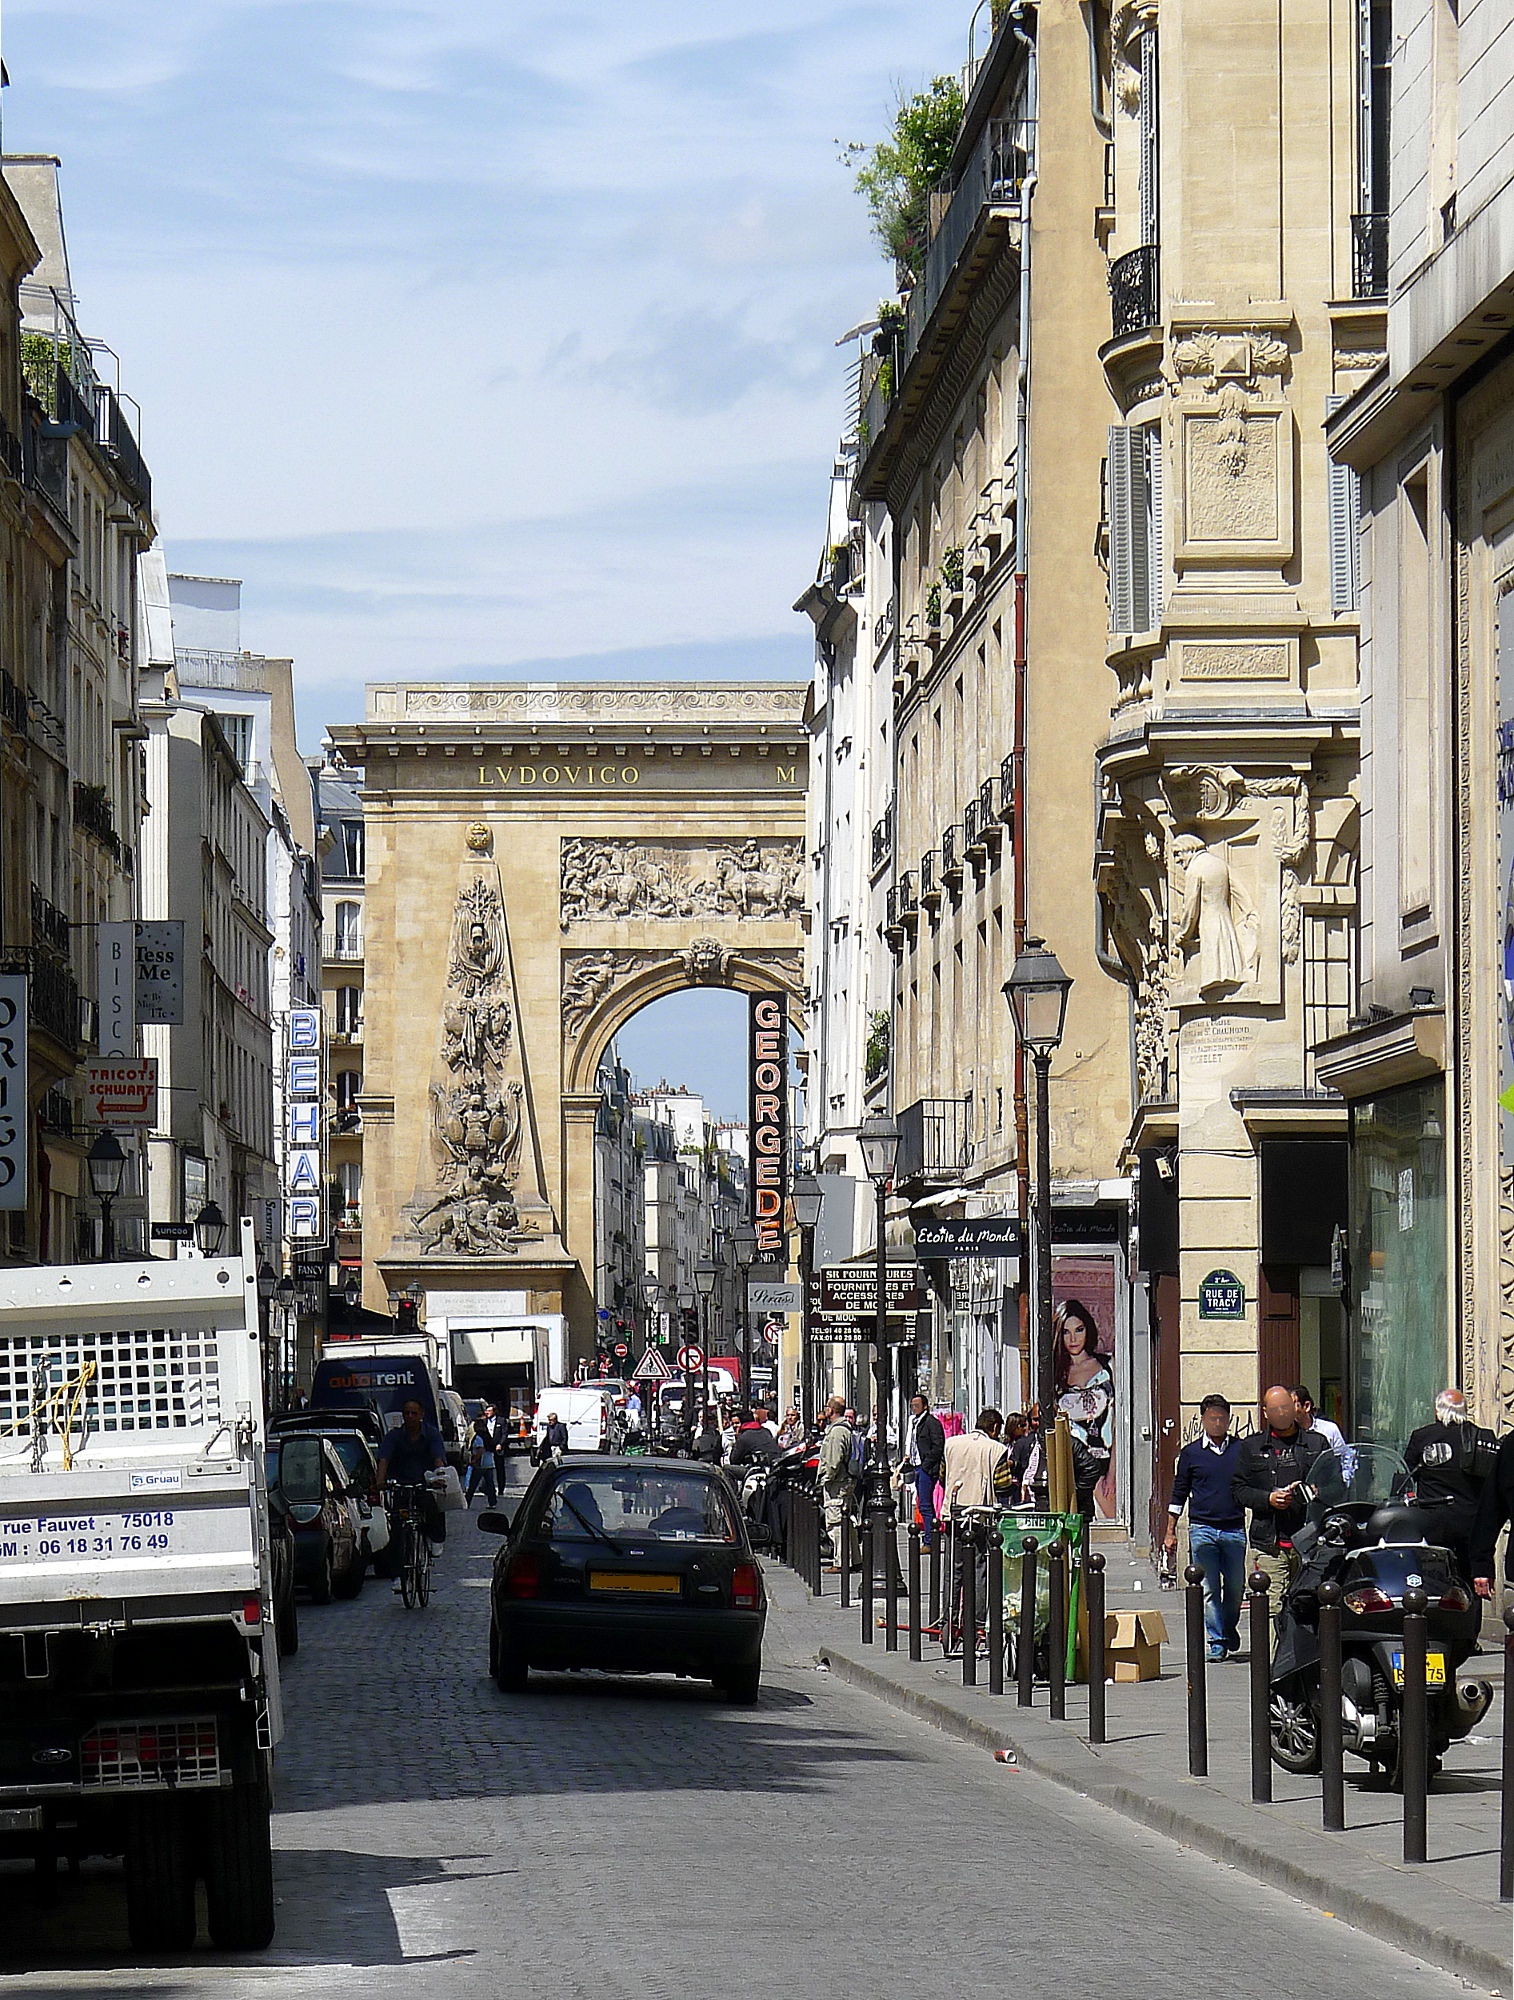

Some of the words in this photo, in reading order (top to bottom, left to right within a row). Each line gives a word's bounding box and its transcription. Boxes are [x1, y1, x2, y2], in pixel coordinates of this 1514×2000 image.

[478, 766, 640, 785] LVDOVICO
[135, 946, 174, 963] Tess
[138, 964, 171, 980] Me
[90, 1069, 155, 1080] TRICOTS
[89, 1084, 155, 1096] SCHWARZ
[291, 1012, 318, 1236] BEHAR
[917, 1226, 955, 1244] Etoile
[957, 1226, 974, 1243] du
[977, 1226, 1017, 1243] Monde
[298, 1265, 324, 1274] FANCY
[843, 1270, 914, 1279] FOURNURES
[827, 1282, 899, 1291] FOURNITUES
[901, 1282, 916, 1291] ET
[832, 1292, 905, 1300] ACCESSORES
[1205, 1289, 1223, 1298] RUE
[1226, 1289, 1239, 1298] DE
[845, 1301, 860, 1310] DE
[863, 1301, 895, 1310] MOE
[1207, 1298, 1237, 1307] TRACY
[145, 1474, 179, 1485] Gruau
[3, 1522, 32, 1535] rue
[37, 1517, 96, 1533] Fauvet
[121, 1511, 174, 1529] 75018
[39, 1540, 61, 1555] 06
[67, 1538, 88, 1554] 18
[93, 1537, 113, 1552] 31
[120, 1535, 142, 1551] 76
[147, 1533, 169, 1549] 49
[1427, 1668, 1444, 1681] 75
